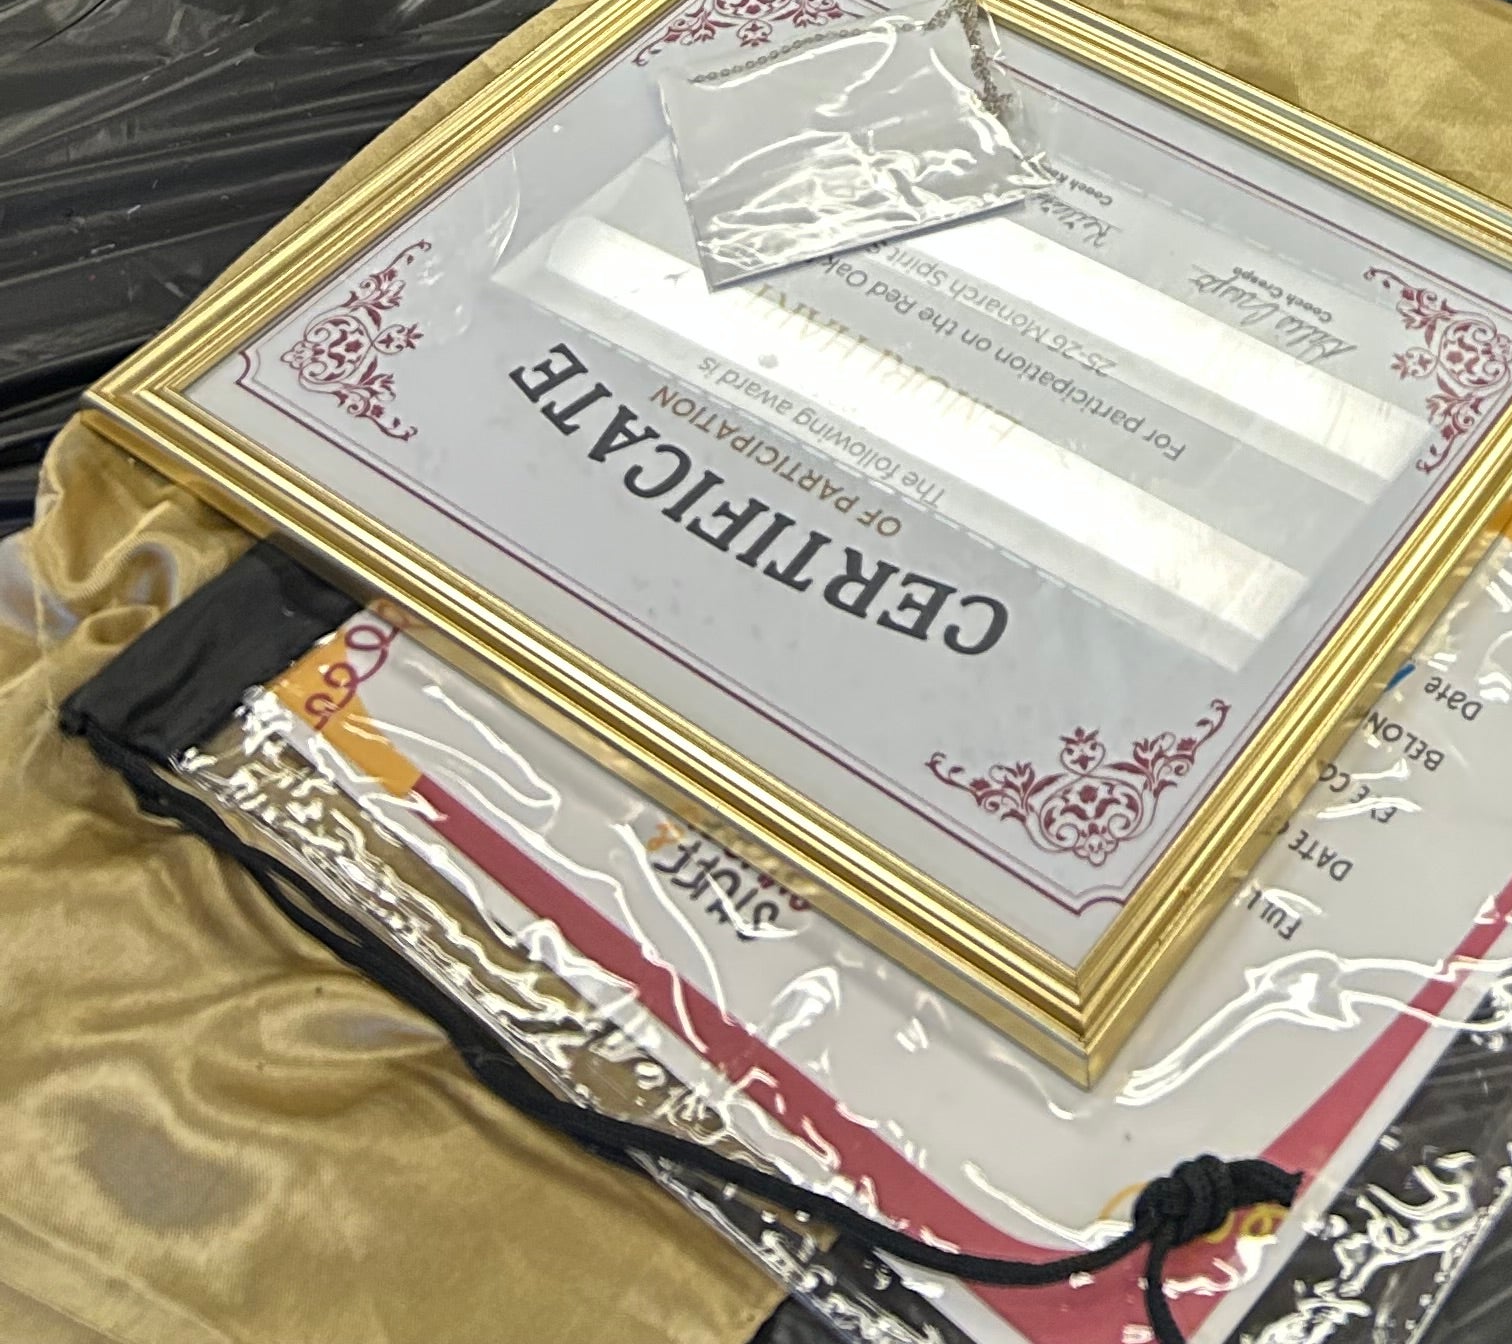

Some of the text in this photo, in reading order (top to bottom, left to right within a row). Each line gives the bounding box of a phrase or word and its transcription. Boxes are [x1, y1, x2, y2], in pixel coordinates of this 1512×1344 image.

[1069, 179, 1112, 206] Coach
[818, 252, 1185, 461] For participation on the Red Oak
[890, 247, 1120, 376] 25-26 Monarch Spirit
[1231, 267, 1332, 323] Coach Crespo
[649, 378, 901, 536] OF PARTICIPATION
[697, 352, 943, 511] The following award is
[508, 343, 1007, 655] CERTIFICATE
[1424, 675, 1484, 722] Date
[1288, 831, 1354, 883] DATE
